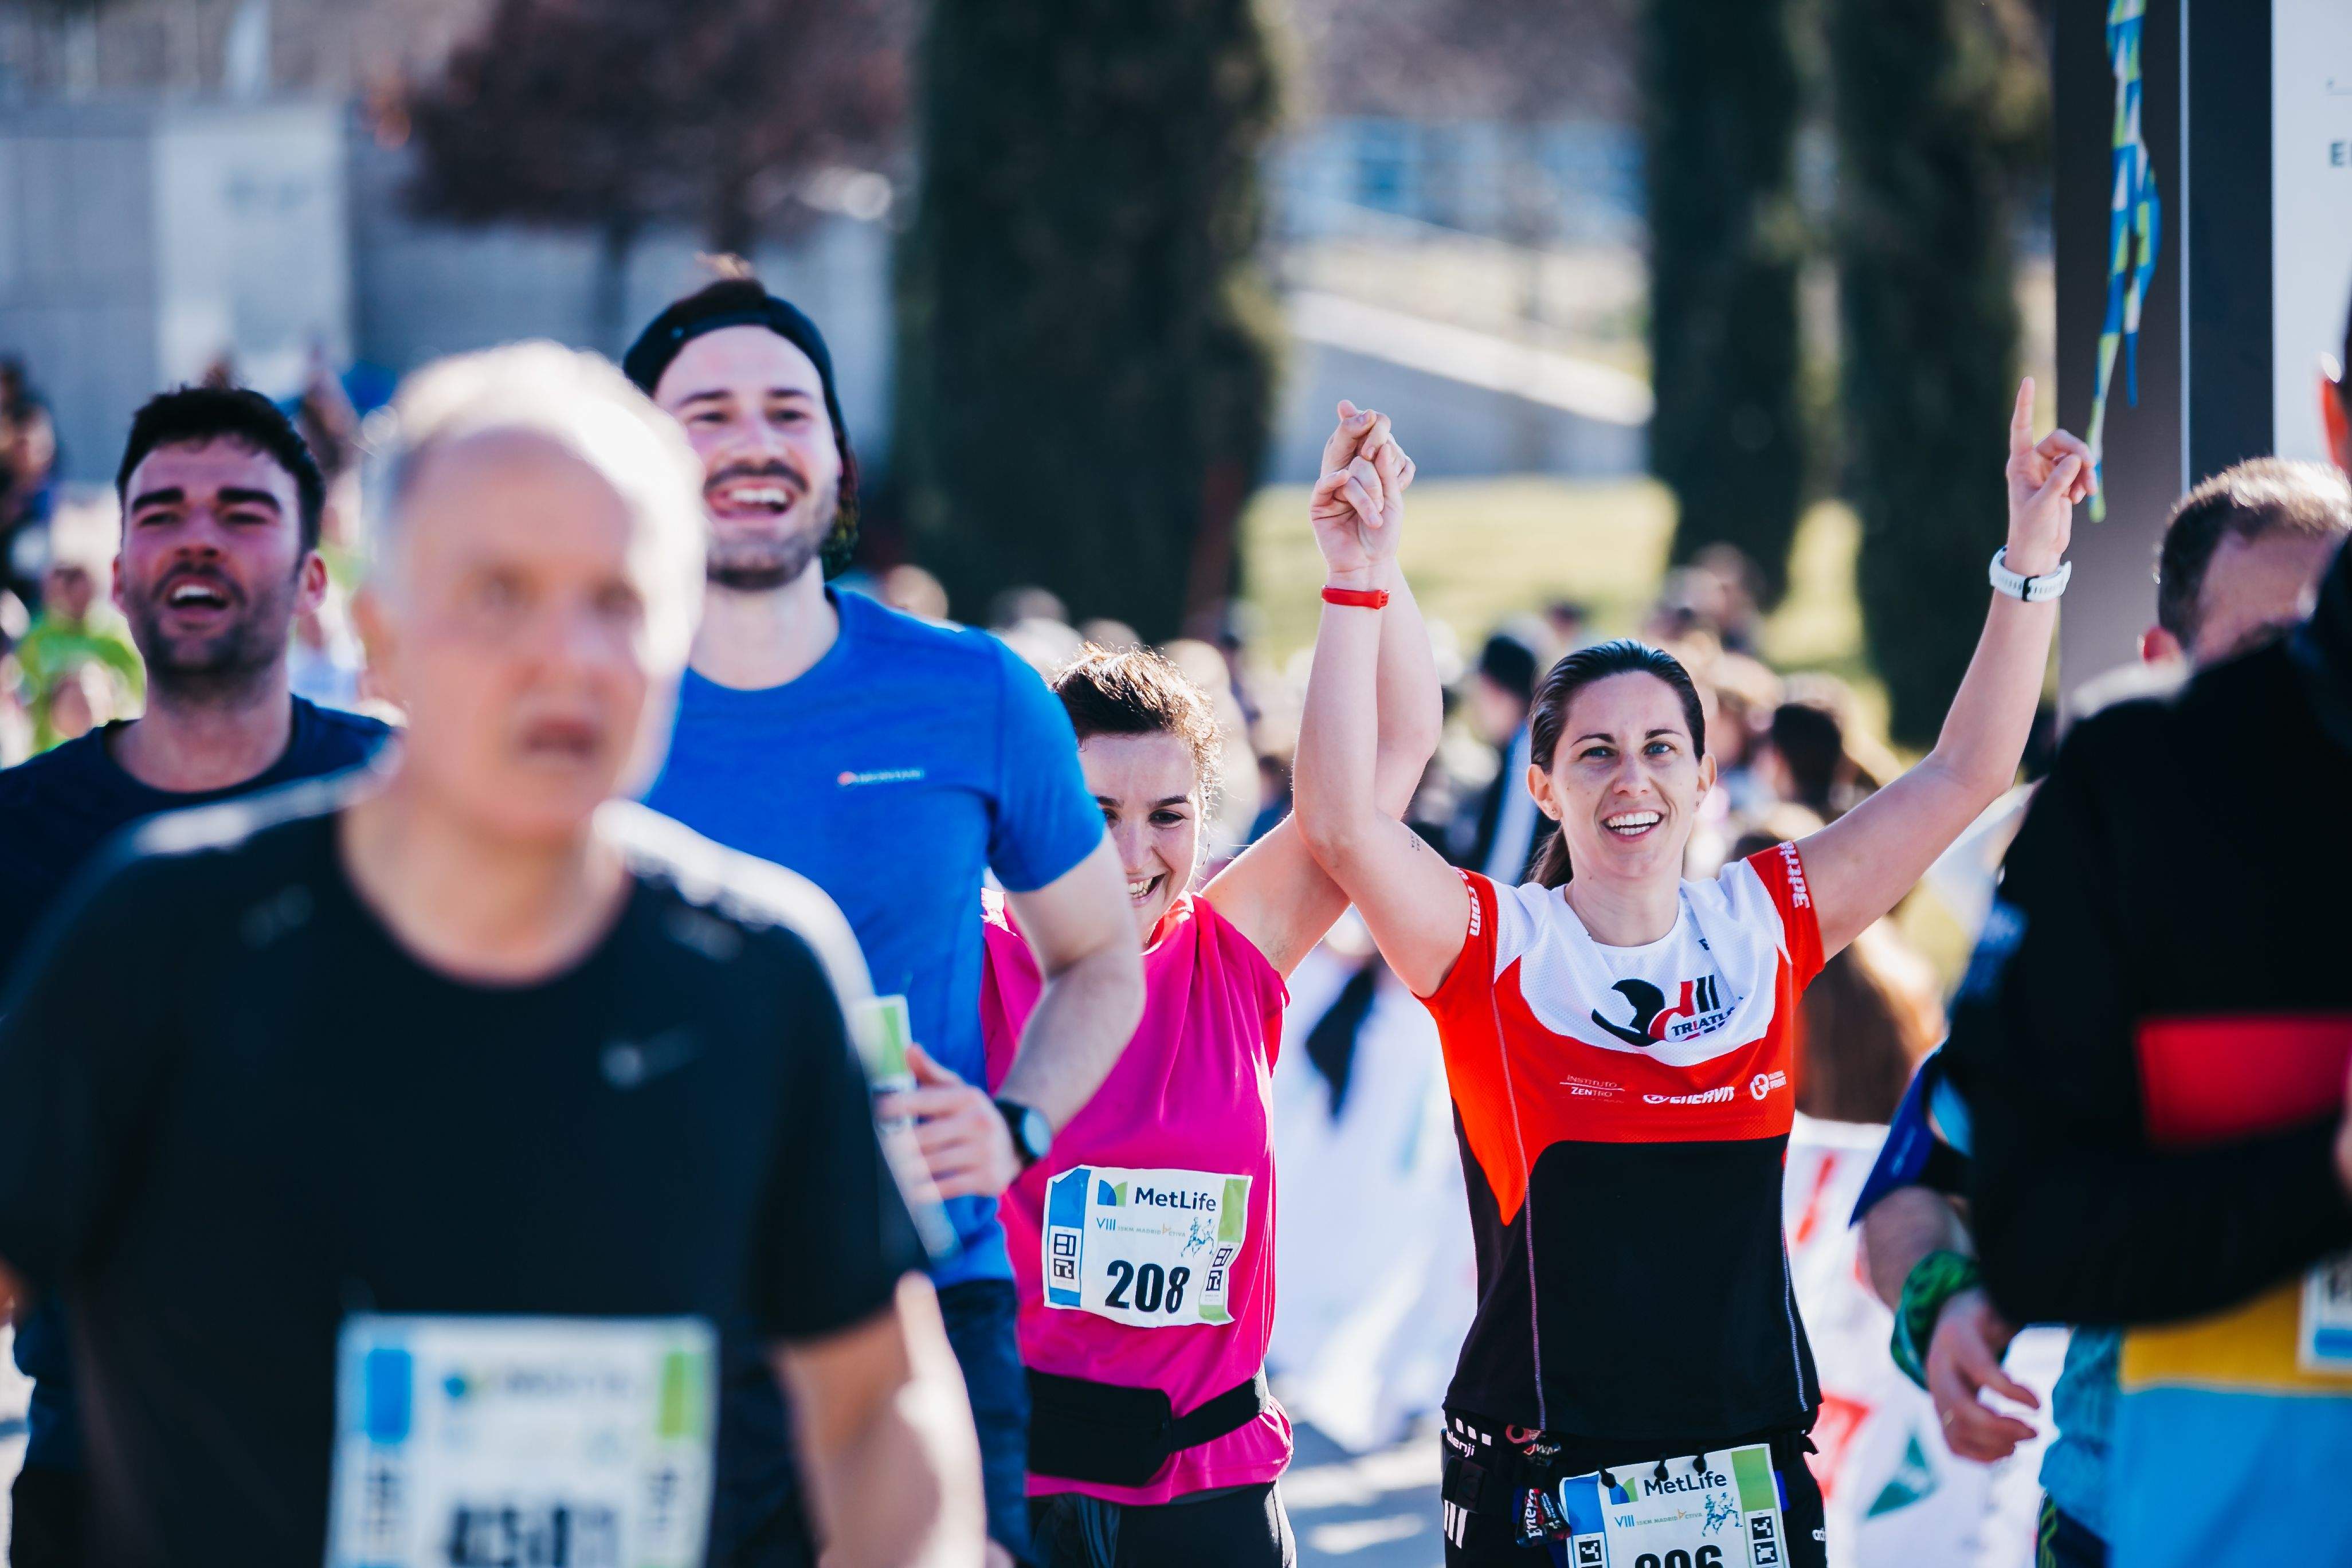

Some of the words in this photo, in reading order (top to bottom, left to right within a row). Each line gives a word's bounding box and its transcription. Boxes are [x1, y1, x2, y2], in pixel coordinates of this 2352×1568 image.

[1135, 1187, 1216, 1212] MetLife
[1096, 1217, 1116, 1231] VIII
[1105, 1260, 1190, 1314] 208
[1644, 1471, 1727, 1496] MetLife
[1614, 1515, 1635, 1528] VIII
